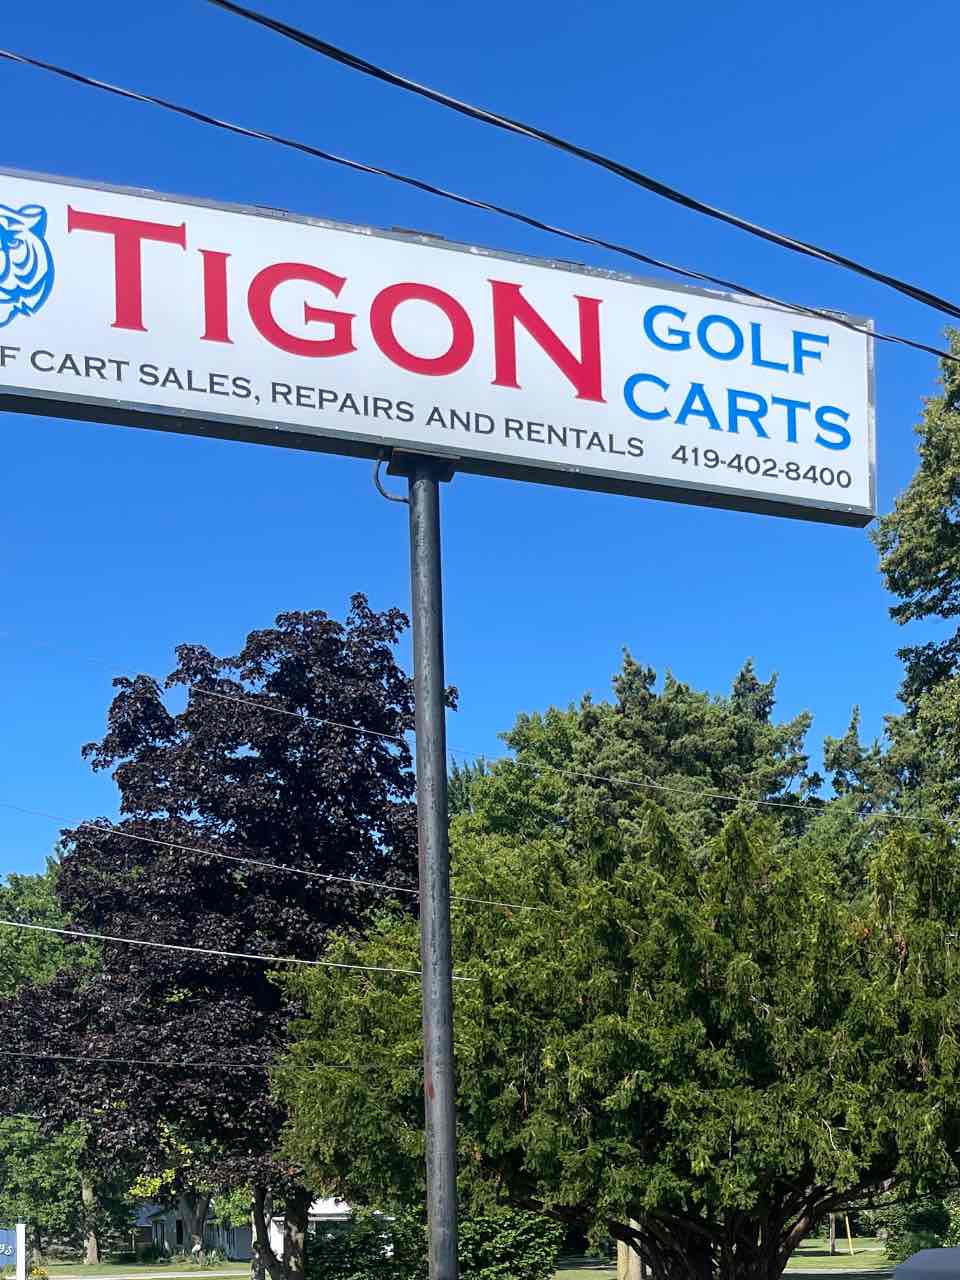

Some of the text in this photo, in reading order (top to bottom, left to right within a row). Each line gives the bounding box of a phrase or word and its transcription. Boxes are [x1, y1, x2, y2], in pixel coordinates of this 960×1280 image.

[67, 204, 607, 404] TIGON
[642, 304, 829, 375] GOLF
[30, 349, 130, 382] CART
[139, 363, 261, 406] SALES,
[271, 381, 415, 424] REPAIRS
[424, 406, 495, 436] AND
[504, 417, 644, 458] RENTALS
[623, 372, 852, 451] CARTS
[671, 444, 852, 489] 419-402-8400
